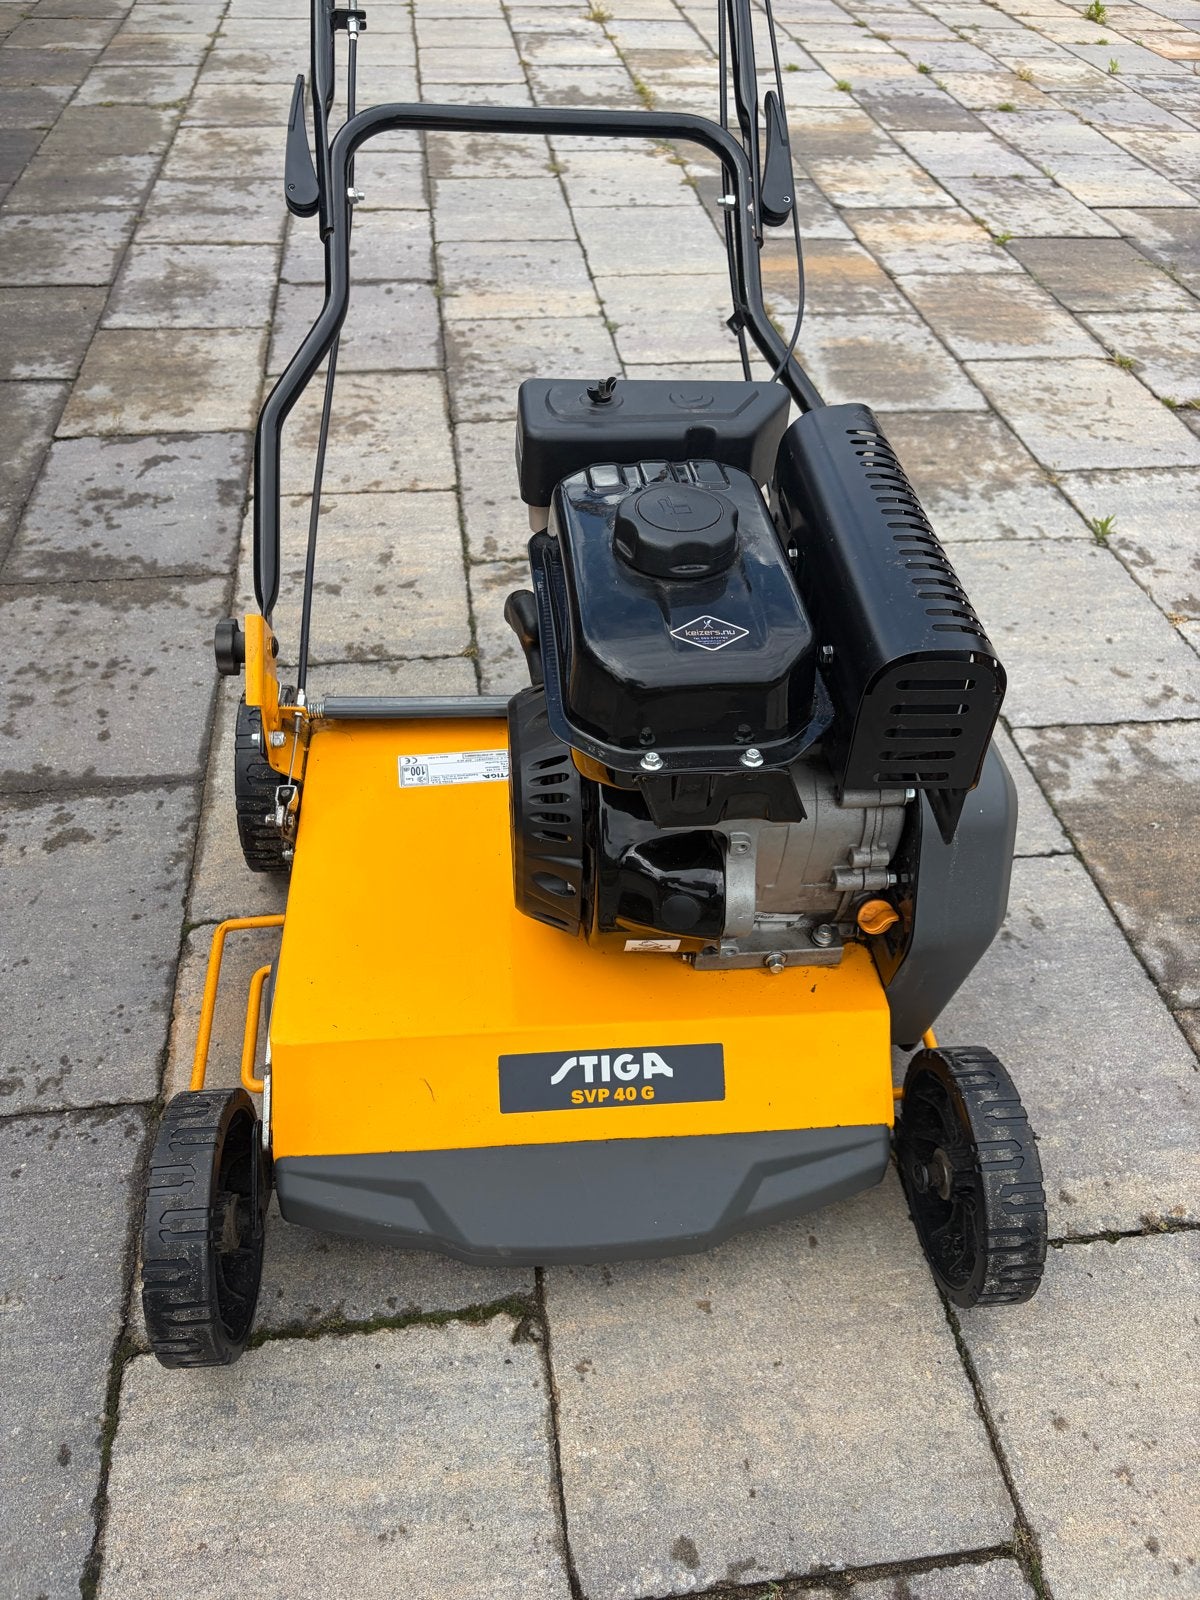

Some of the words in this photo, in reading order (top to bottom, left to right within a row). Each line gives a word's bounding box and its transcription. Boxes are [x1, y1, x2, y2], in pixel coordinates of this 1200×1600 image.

[410, 766, 426, 776] 100
[551, 1052, 674, 1085] STIGA
[571, 1088, 609, 1104] SVP
[614, 1087, 636, 1102] 40
[641, 1086, 655, 1099] G
